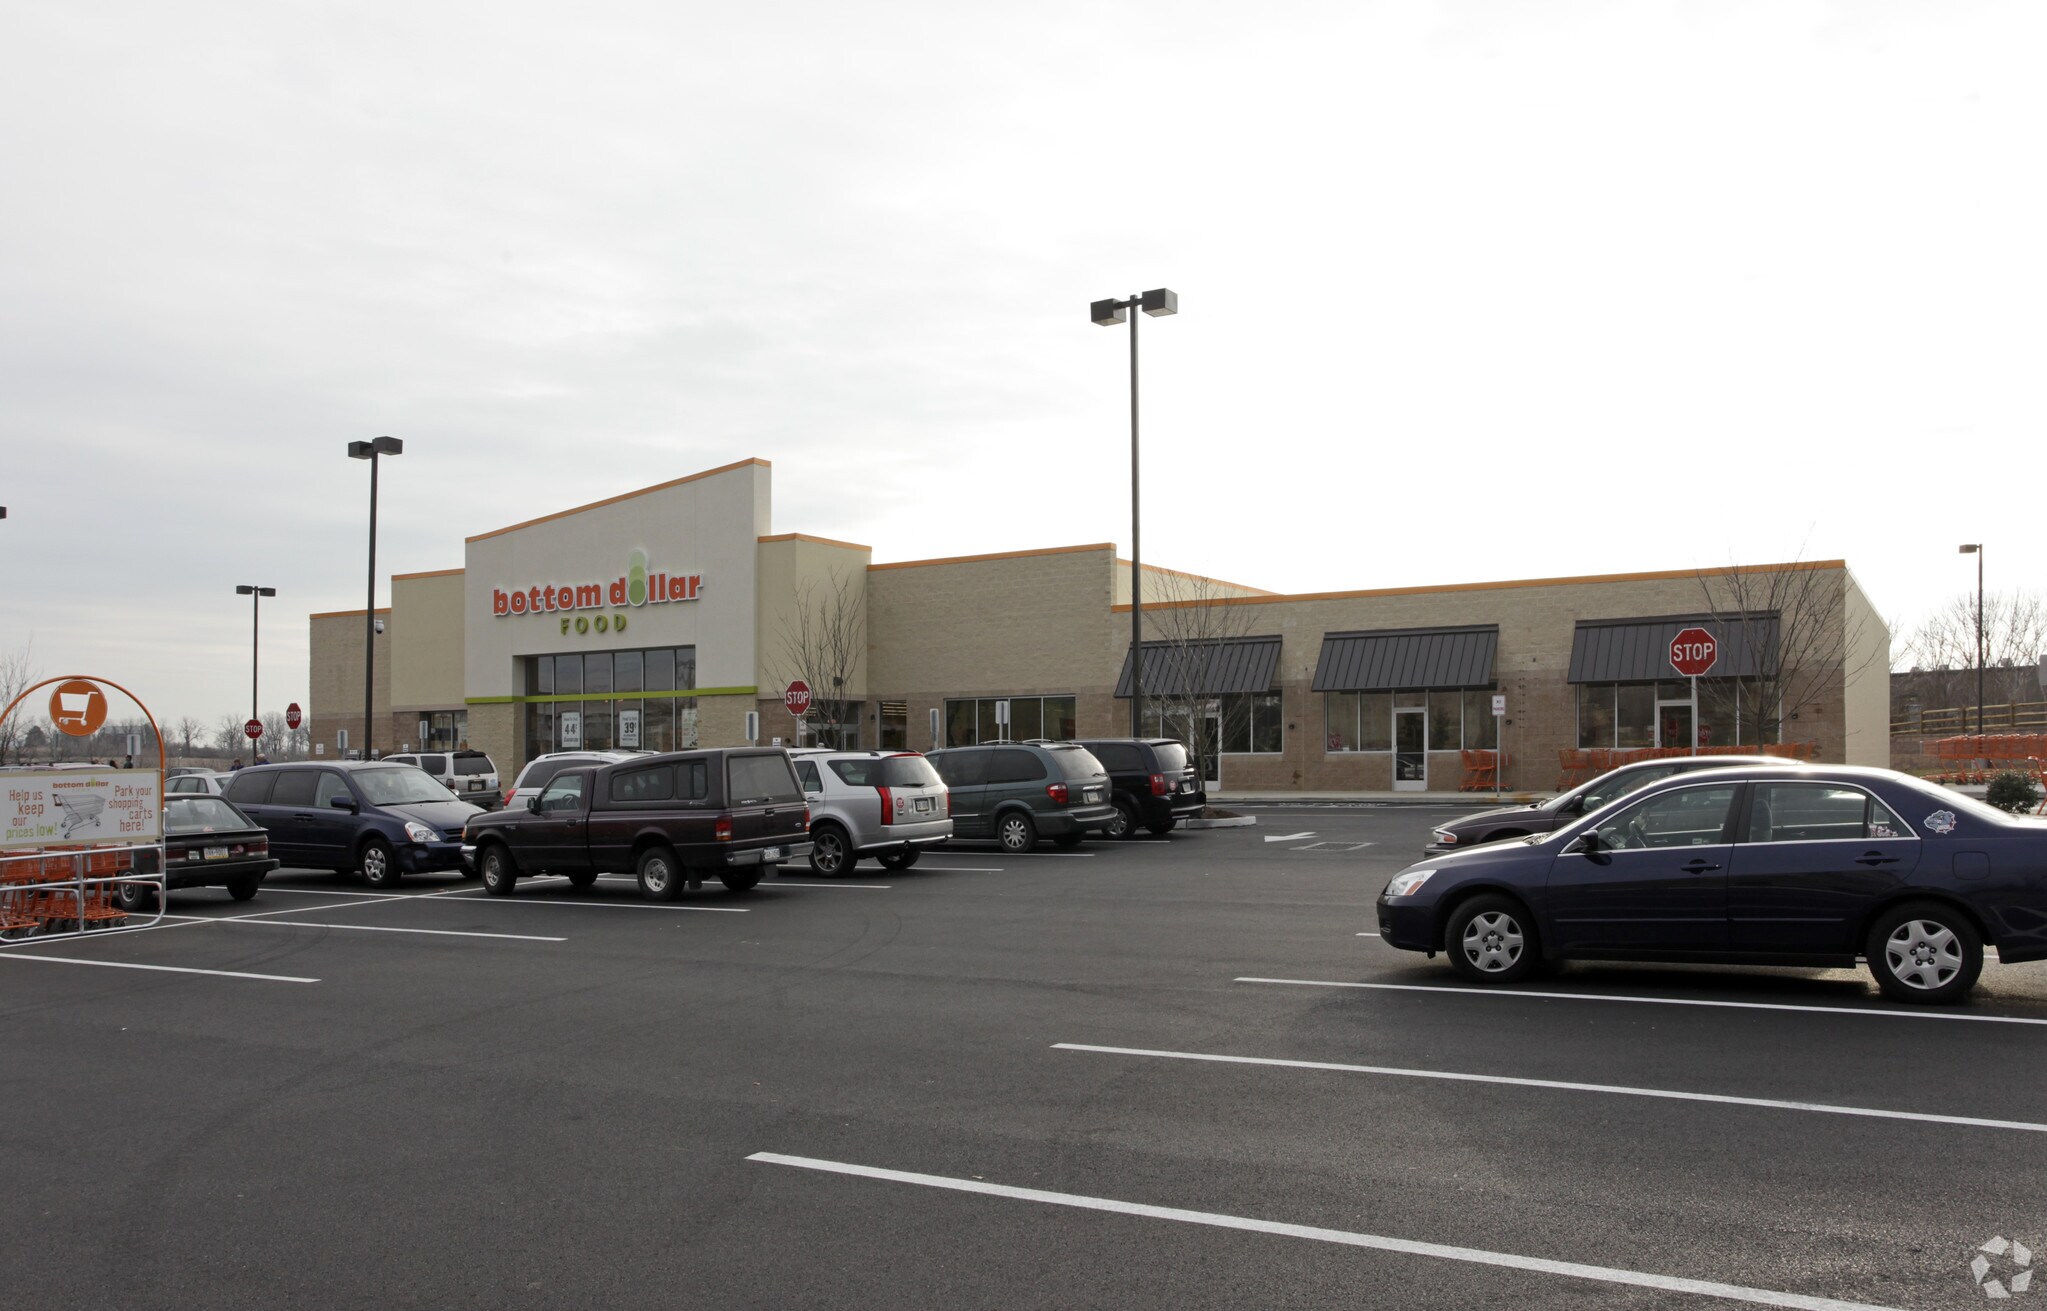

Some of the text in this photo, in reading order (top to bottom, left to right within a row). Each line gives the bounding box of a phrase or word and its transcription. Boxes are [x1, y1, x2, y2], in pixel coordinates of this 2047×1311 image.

[493, 562, 702, 615] bottom dollar
[560, 613, 627, 635] FOOD
[1673, 642, 1714, 662] STOP
[787, 691, 809, 705] STOP
[287, 711, 301, 722] STOP
[245, 725, 262, 733] STOP
[52, 781, 84, 789] bottom
[114, 785, 152, 797] Park your
[9, 789, 43, 803] Help us
[18, 802, 44, 817] keep
[108, 799, 144, 810] shopping
[12, 816, 27, 827] our
[128, 809, 153, 820] carts
[6, 822, 58, 841] prices low!
[119, 818, 145, 832] here!
